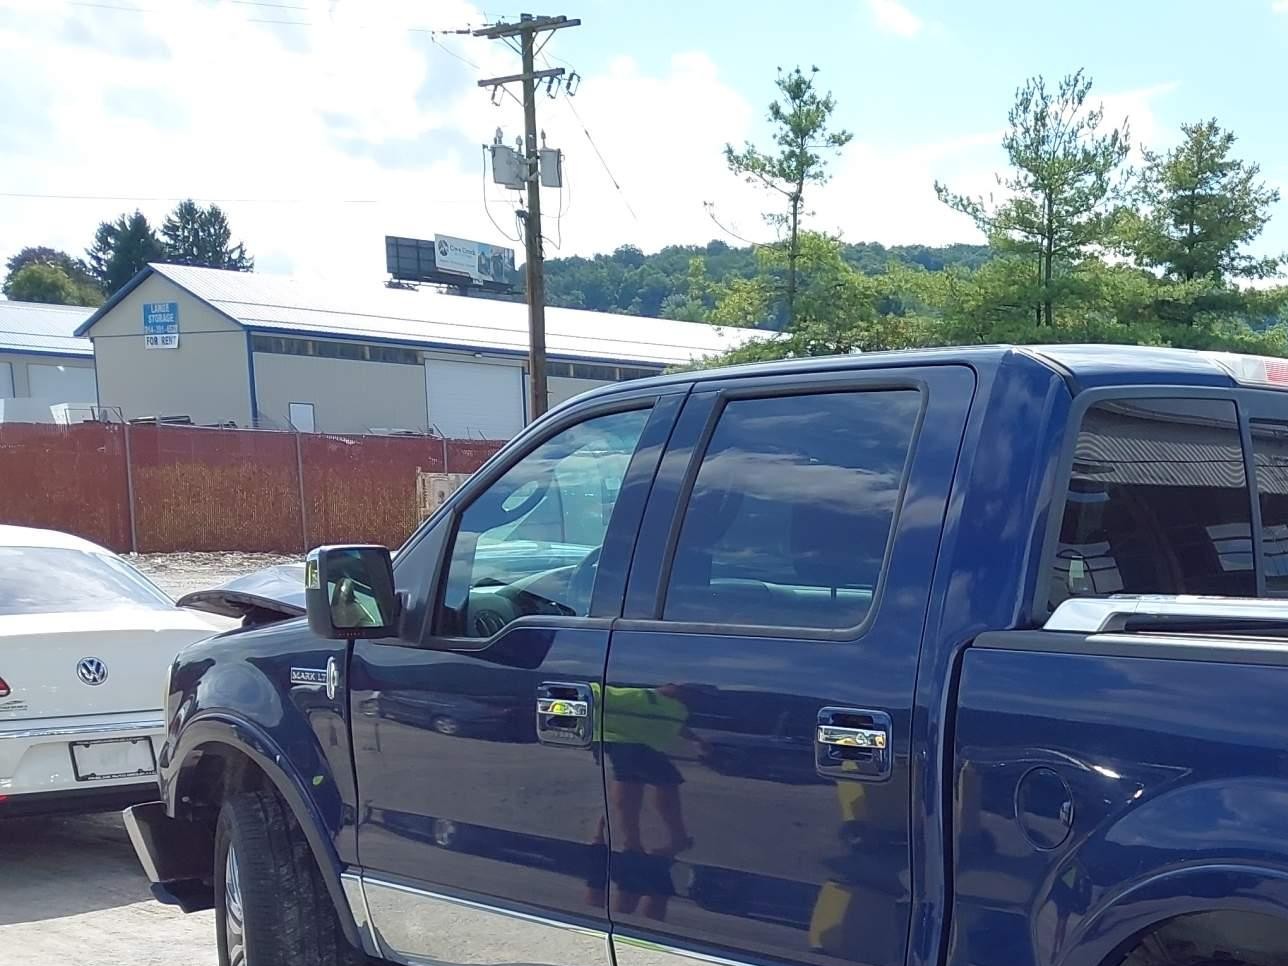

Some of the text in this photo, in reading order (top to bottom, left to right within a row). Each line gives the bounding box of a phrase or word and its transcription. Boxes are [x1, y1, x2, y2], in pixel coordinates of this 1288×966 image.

[150, 303, 170, 313] LARGE
[148, 313, 175, 323] STORAGE
[146, 335, 177, 345] FOR RENT
[292, 671, 327, 682] MARK LT
